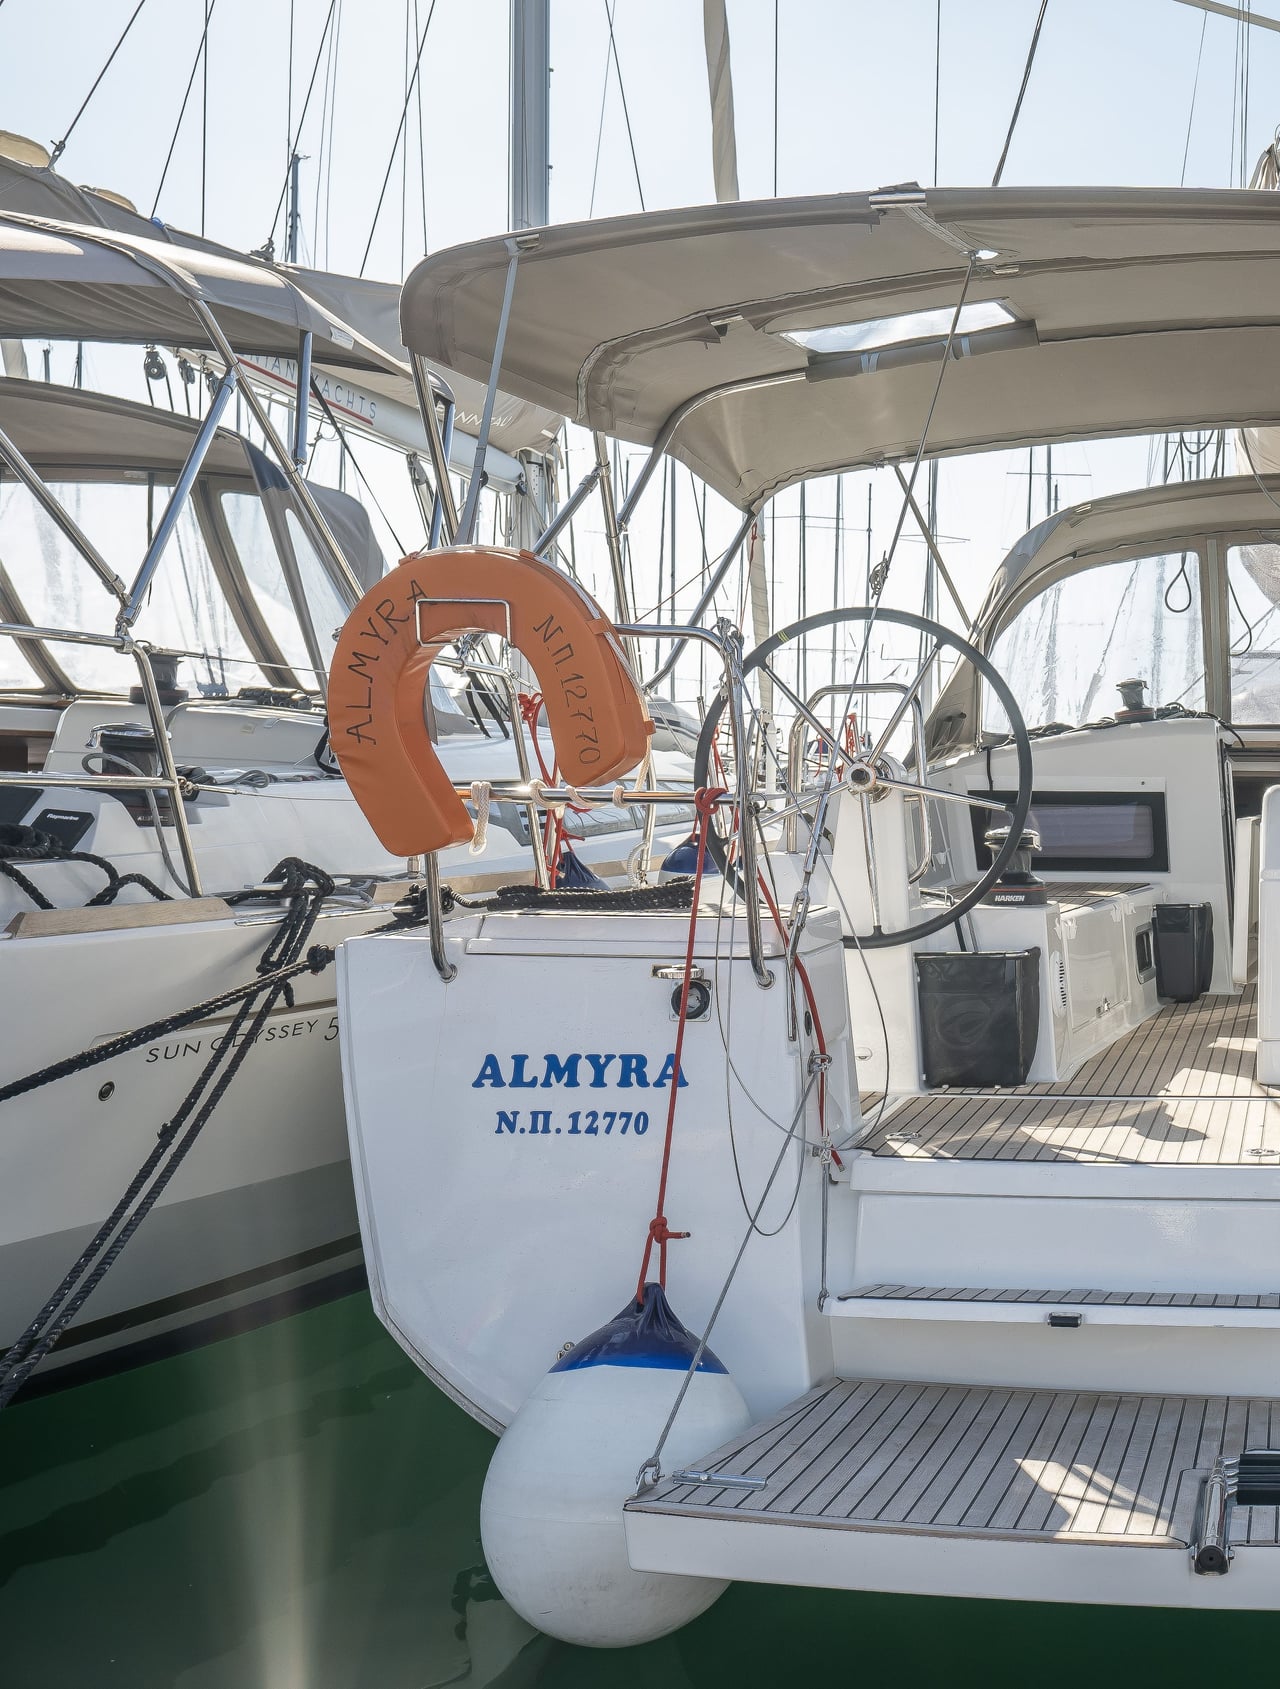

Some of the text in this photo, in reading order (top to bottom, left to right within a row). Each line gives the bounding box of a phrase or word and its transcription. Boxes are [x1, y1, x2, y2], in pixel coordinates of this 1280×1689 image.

[346, 579, 438, 746] ALMYRA
[145, 1040, 201, 1063] SUN
[471, 1053, 690, 1088] ALMYRA
